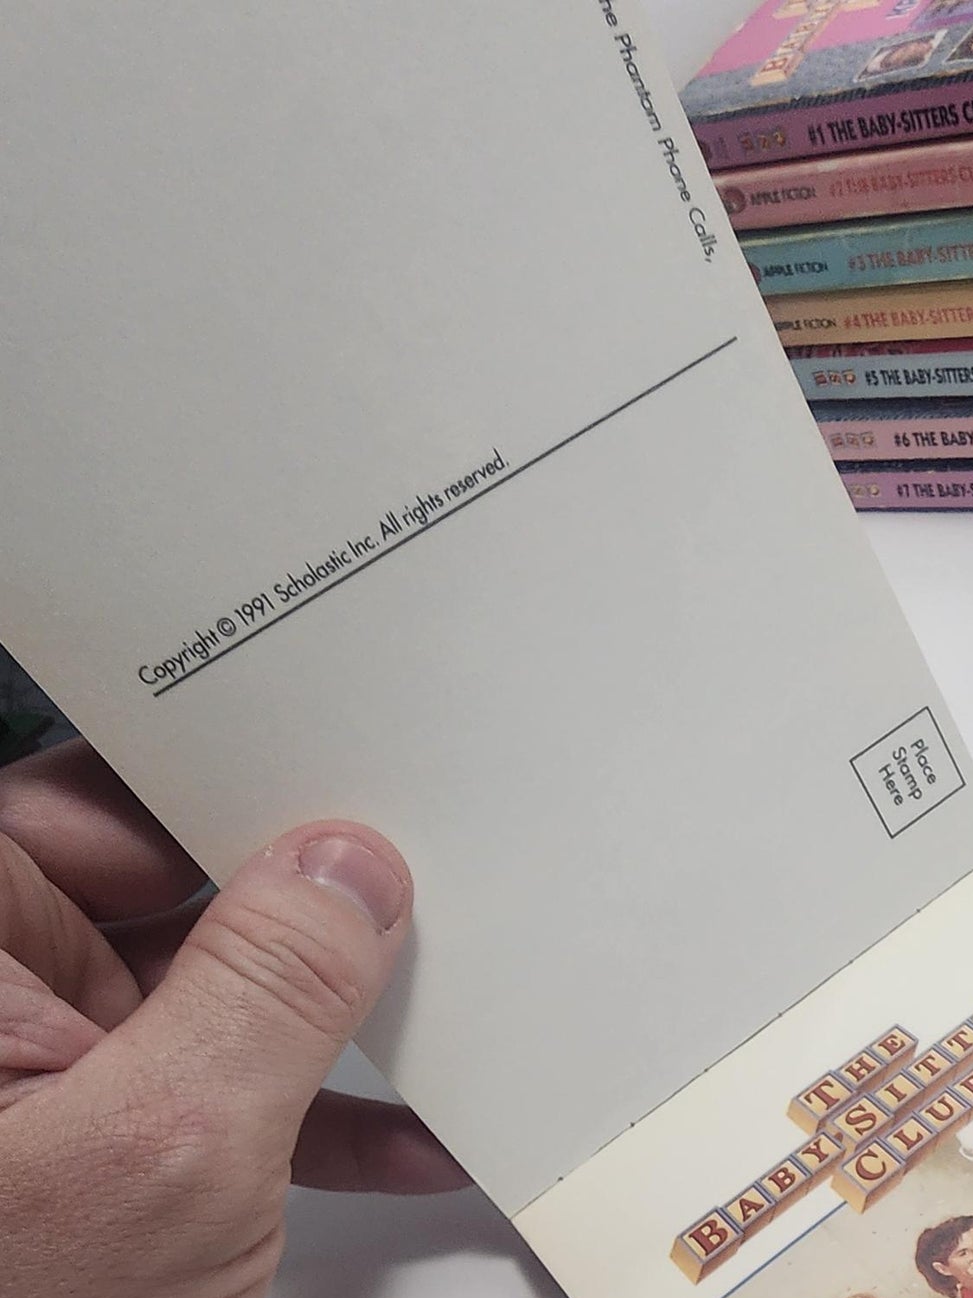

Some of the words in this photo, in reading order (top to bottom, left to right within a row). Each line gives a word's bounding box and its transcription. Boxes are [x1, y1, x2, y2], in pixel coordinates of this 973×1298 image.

[808, 125, 825, 145] #1
[828, 121, 854, 142] THE
[859, 104, 958, 138] BABY-SITTERS
[614, 33, 662, 131] Phantom
[658, 137, 690, 202] Phone
[688, 206, 718, 263] Calls,
[863, 311, 889, 328] THE
[865, 370, 880, 386] #5
[881, 369, 902, 385] THE
[894, 433, 910, 447] #6
[912, 431, 938, 447] THE
[912, 483, 934, 498] THE
[138, 628, 221, 685] Copyright
[235, 593, 276, 629] 1991
[273, 549, 353, 604] Scholastic
[350, 534, 381, 559] Inc.
[379, 511, 403, 541] All
[402, 491, 444, 525] rights
[444, 448, 510, 502] reserved.
[892, 746, 923, 800] Stamp
[910, 738, 937, 785] Place
[878, 763, 904, 806] Here
[804, 1032, 906, 1112] THE
